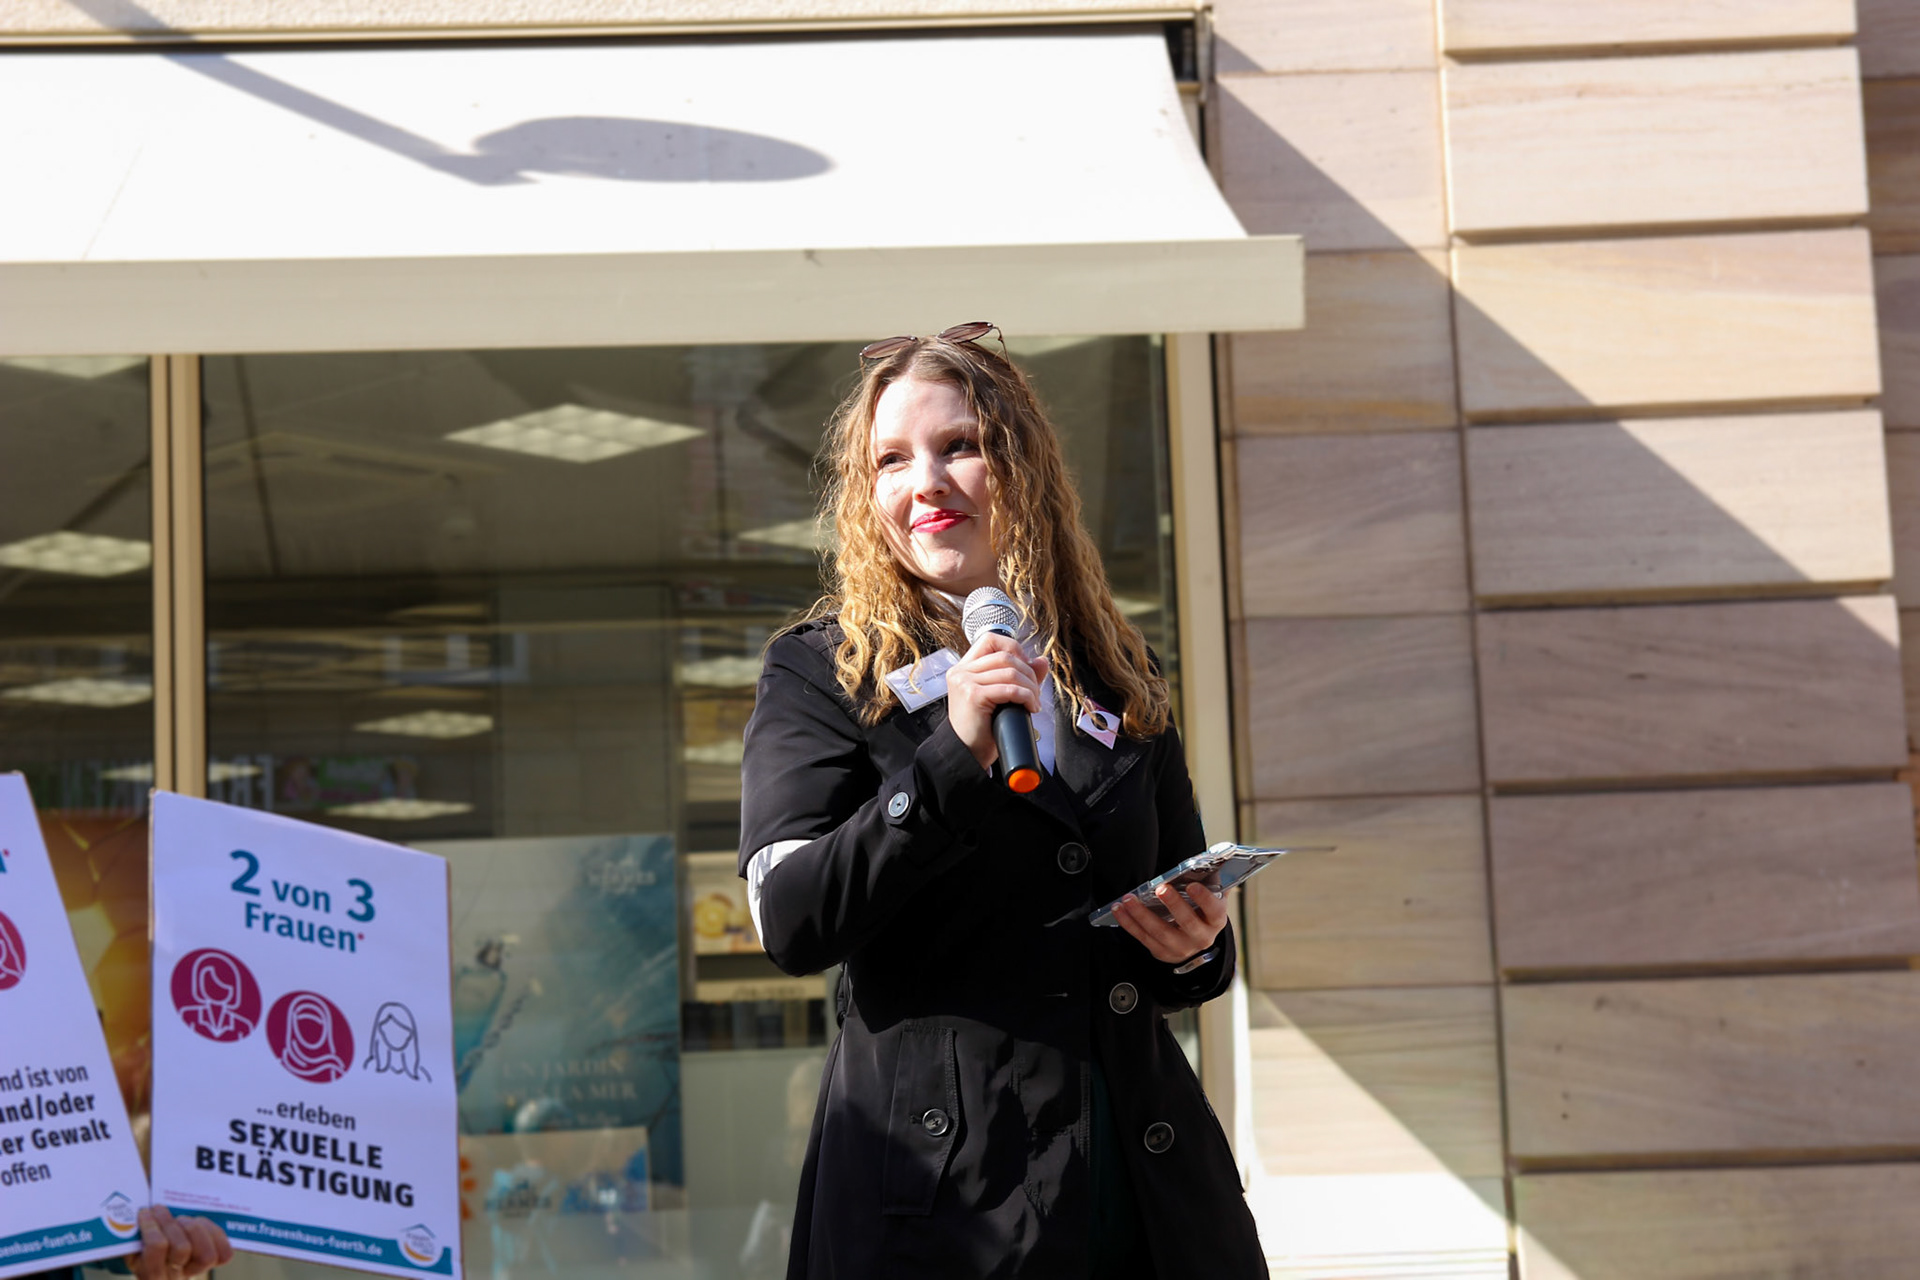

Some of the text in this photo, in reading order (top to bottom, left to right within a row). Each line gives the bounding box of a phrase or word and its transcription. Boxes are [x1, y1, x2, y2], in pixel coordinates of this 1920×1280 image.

[229, 849, 376, 923] 2 von 3
[25, 1066, 52, 1088] ist
[54, 1065, 89, 1084] von
[0, 1119, 112, 1157] er Gewalt
[228, 1118, 384, 1170] SEXUELLE
[1, 1161, 51, 1187] offen
[195, 1145, 414, 1208] BELÄSTIGUNG
[226, 1220, 384, 1257] www.frauenhaus-fuerth.de
